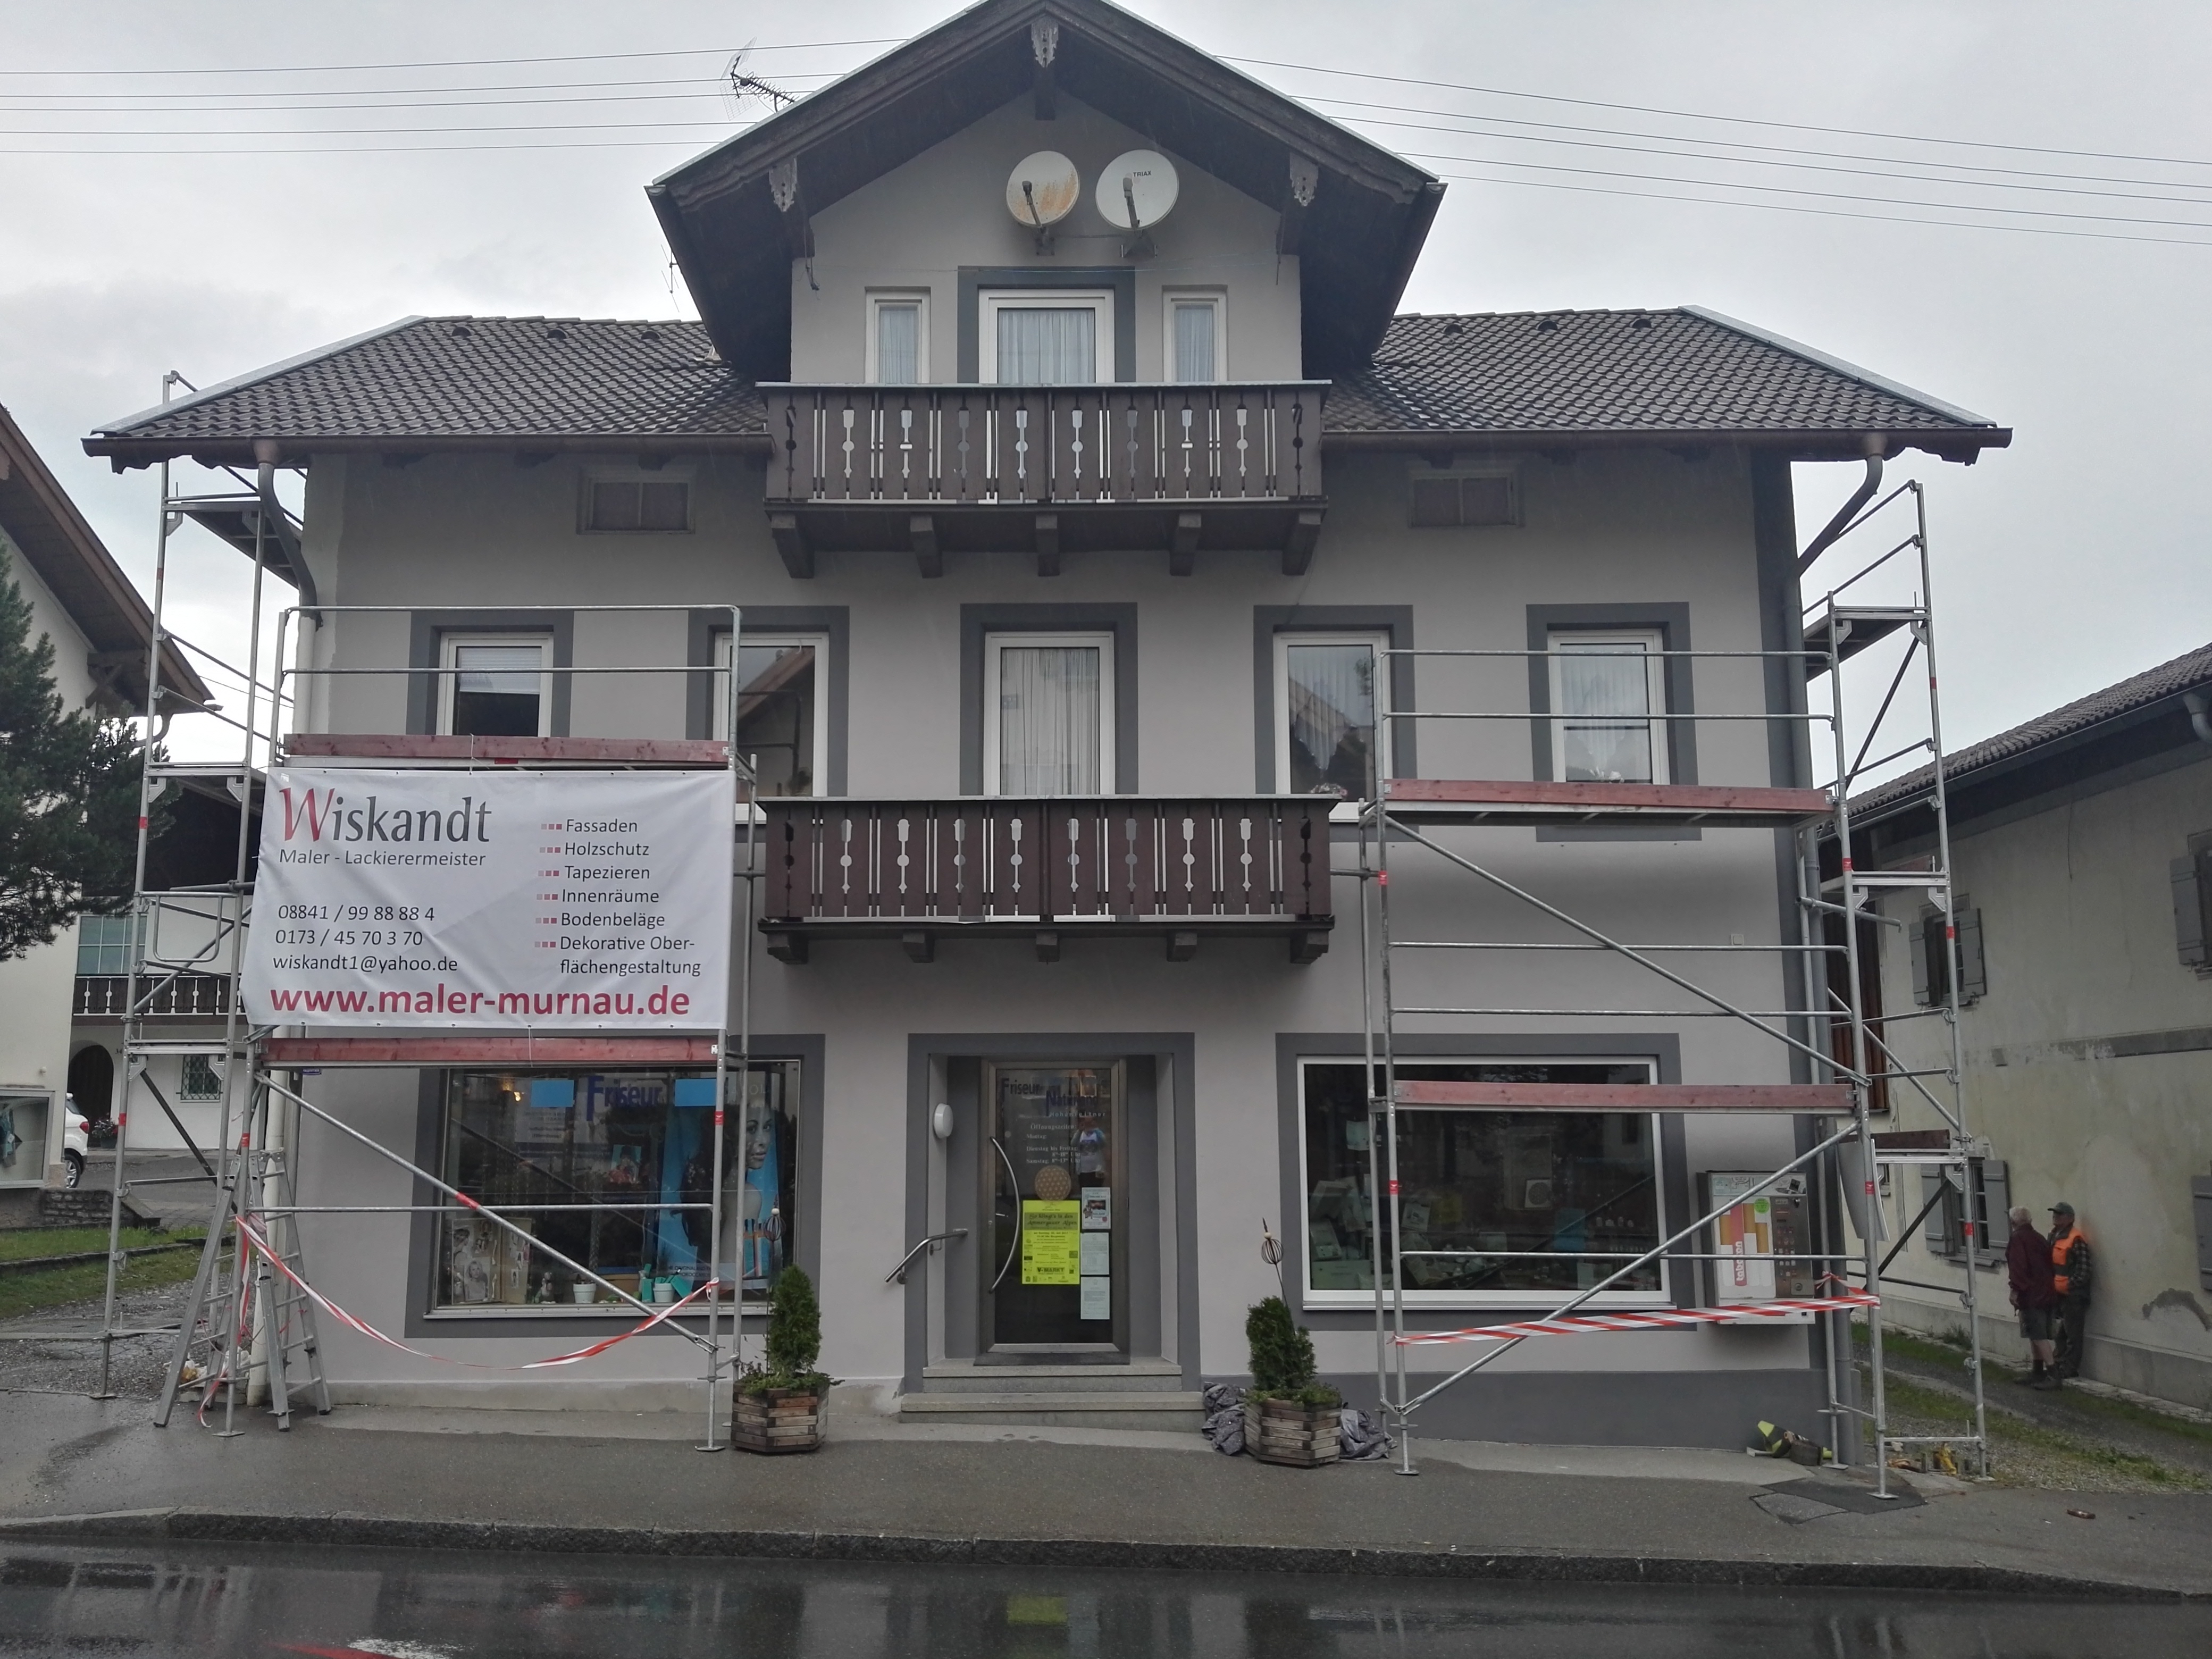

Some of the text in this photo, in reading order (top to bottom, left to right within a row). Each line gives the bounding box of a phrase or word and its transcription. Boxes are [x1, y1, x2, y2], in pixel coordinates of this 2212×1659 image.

[279, 787, 492, 842] Wiskandt
[566, 818, 638, 833] Fassaden
[280, 849, 330, 864] Maler
[345, 850, 486, 866] Lackierermeister
[565, 842, 649, 856] Holzschutz
[564, 866, 650, 882] Tapezieren
[562, 889, 659, 903] Innenräume
[278, 904, 435, 923] 08841 / 99 88 88 4
[561, 912, 665, 929] Bodenbeläge
[275, 929, 423, 947] 0173 / 45 70 3 70
[560, 936, 695, 950] Dekorative Ober-
[273, 954, 458, 974] wiskandt1@yahoo.de
[560, 959, 701, 977] flächengestaltung
[270, 983, 690, 1015] www.maler-murnau.de
[586, 1075, 663, 1121] Friseur
